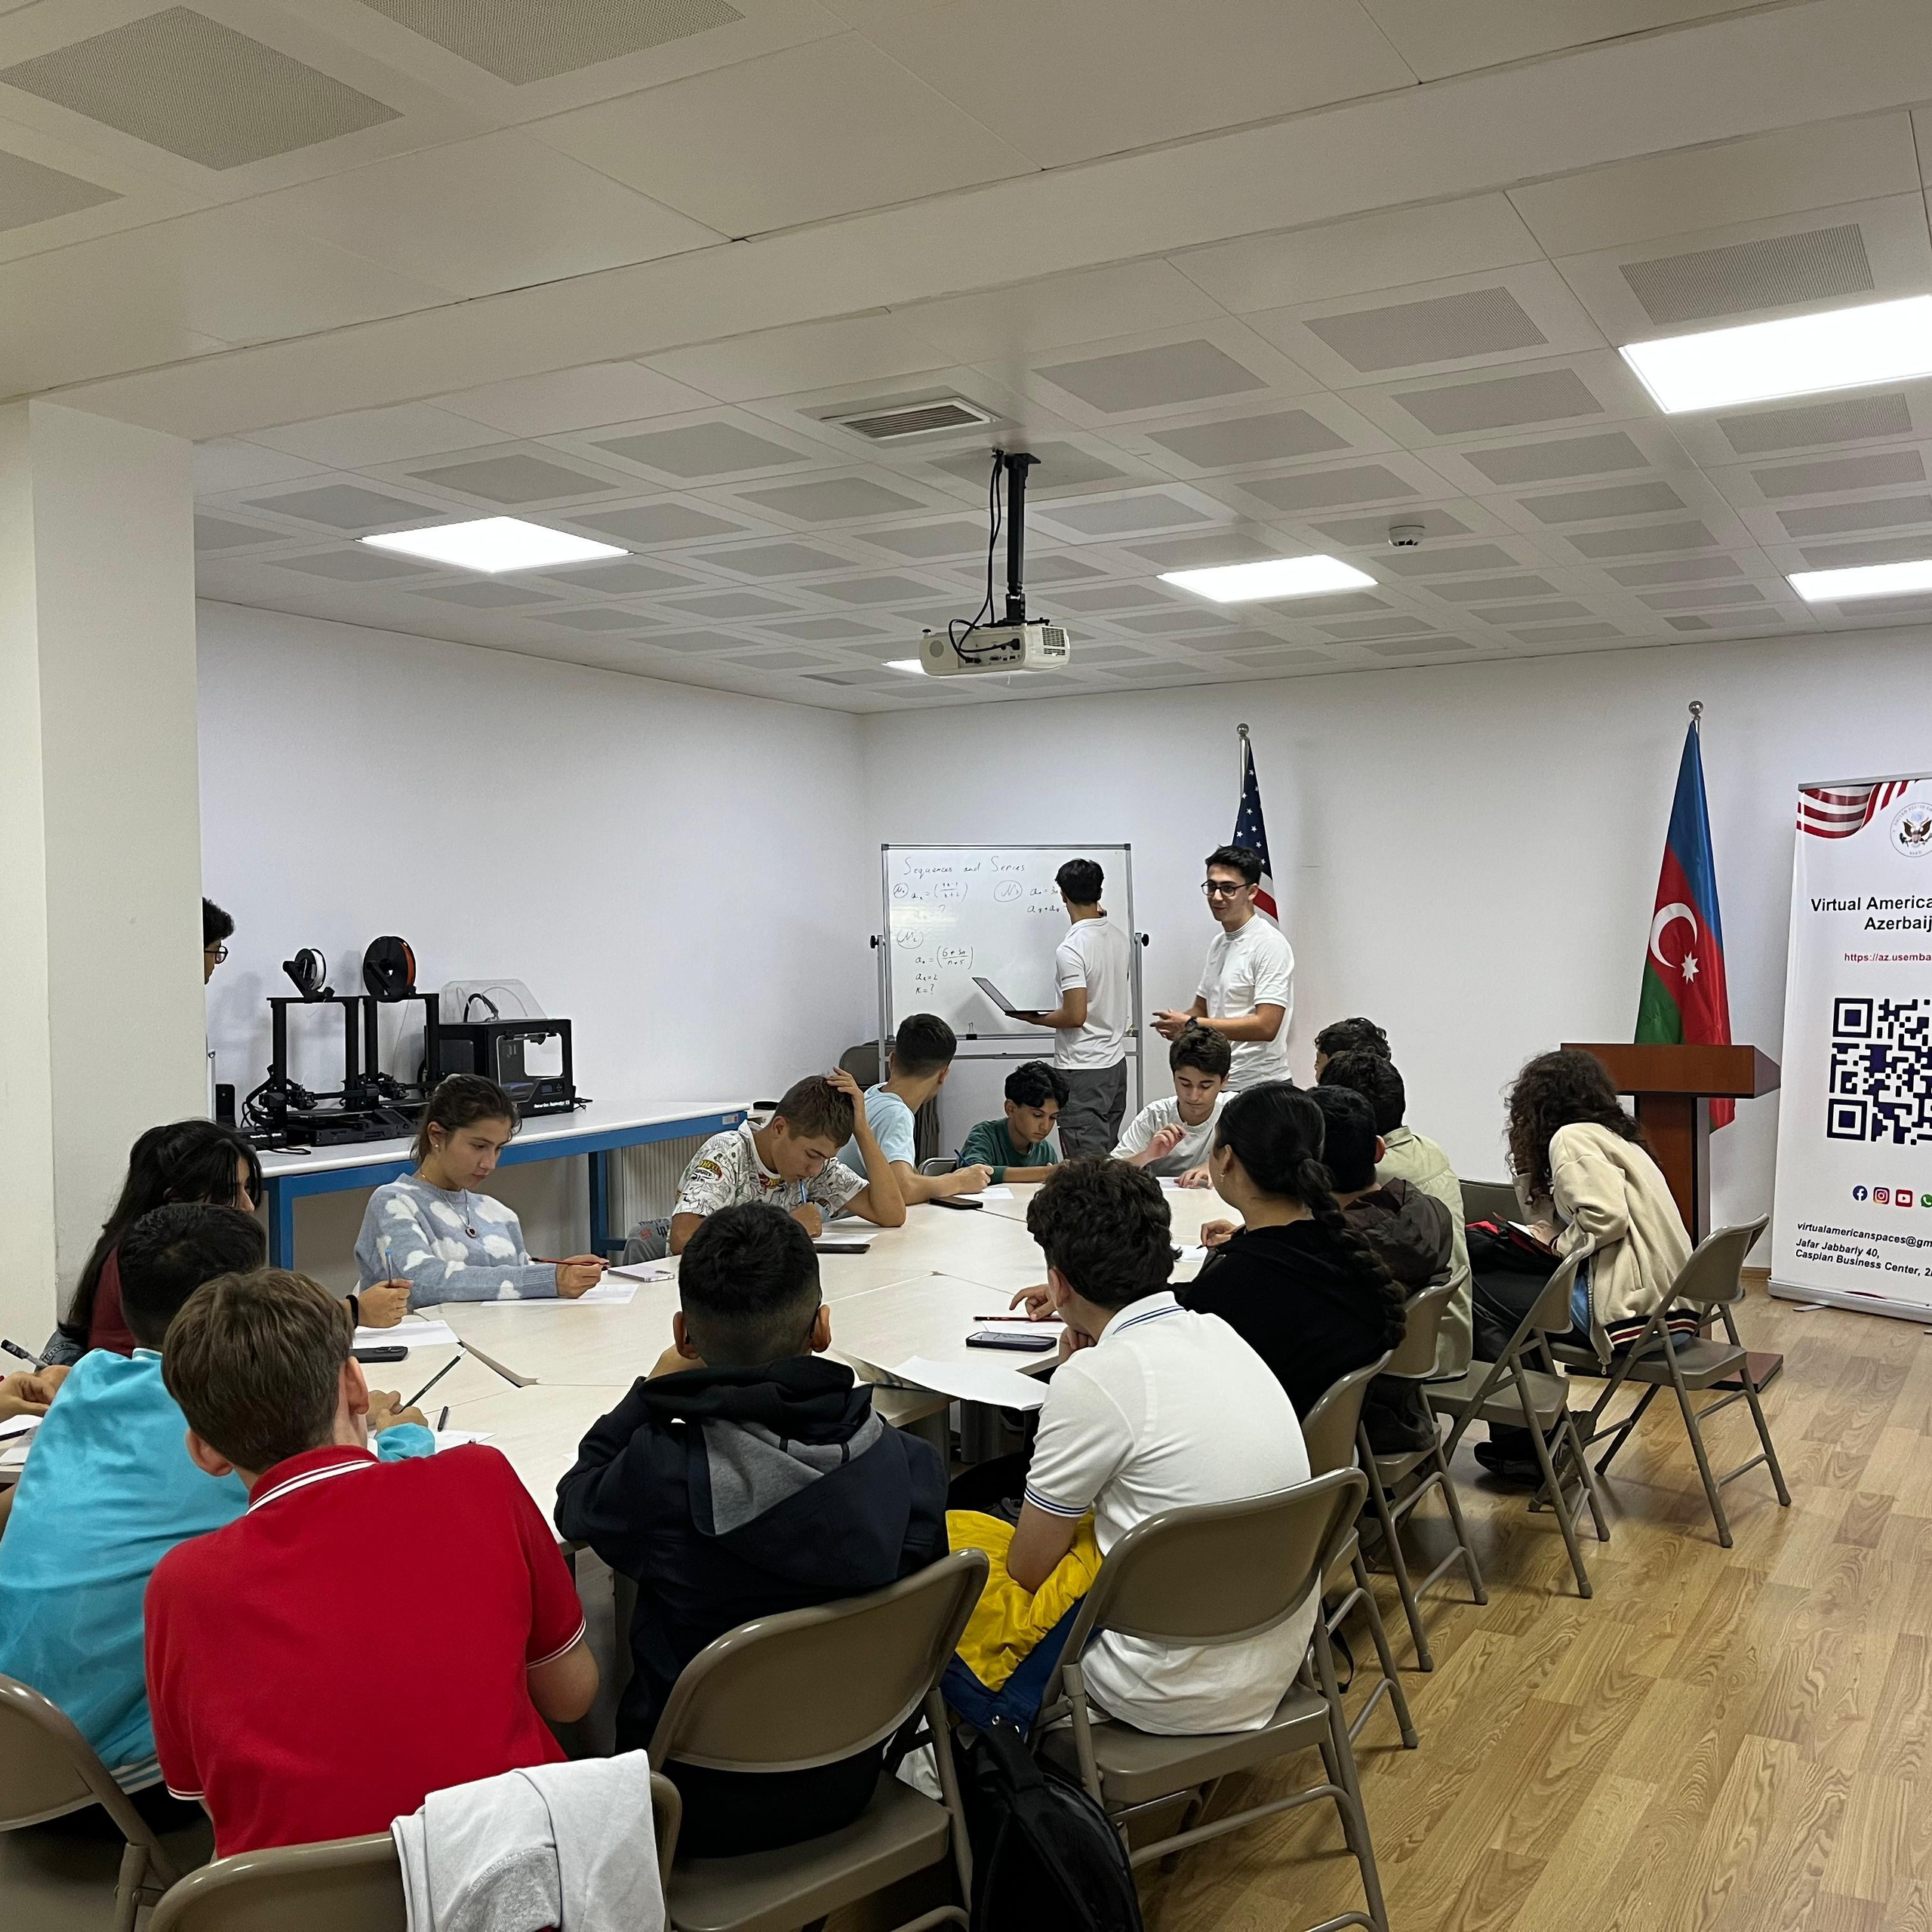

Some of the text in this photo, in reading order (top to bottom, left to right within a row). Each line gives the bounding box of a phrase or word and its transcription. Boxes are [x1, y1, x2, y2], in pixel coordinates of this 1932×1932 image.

[1811, 897, 1861, 912] Virtual
[1795, 1238, 1880, 1259] Jafar Jabbarly 40,
[1836, 1255, 1881, 1269] Business
[1884, 1262, 1921, 1277] Center,
